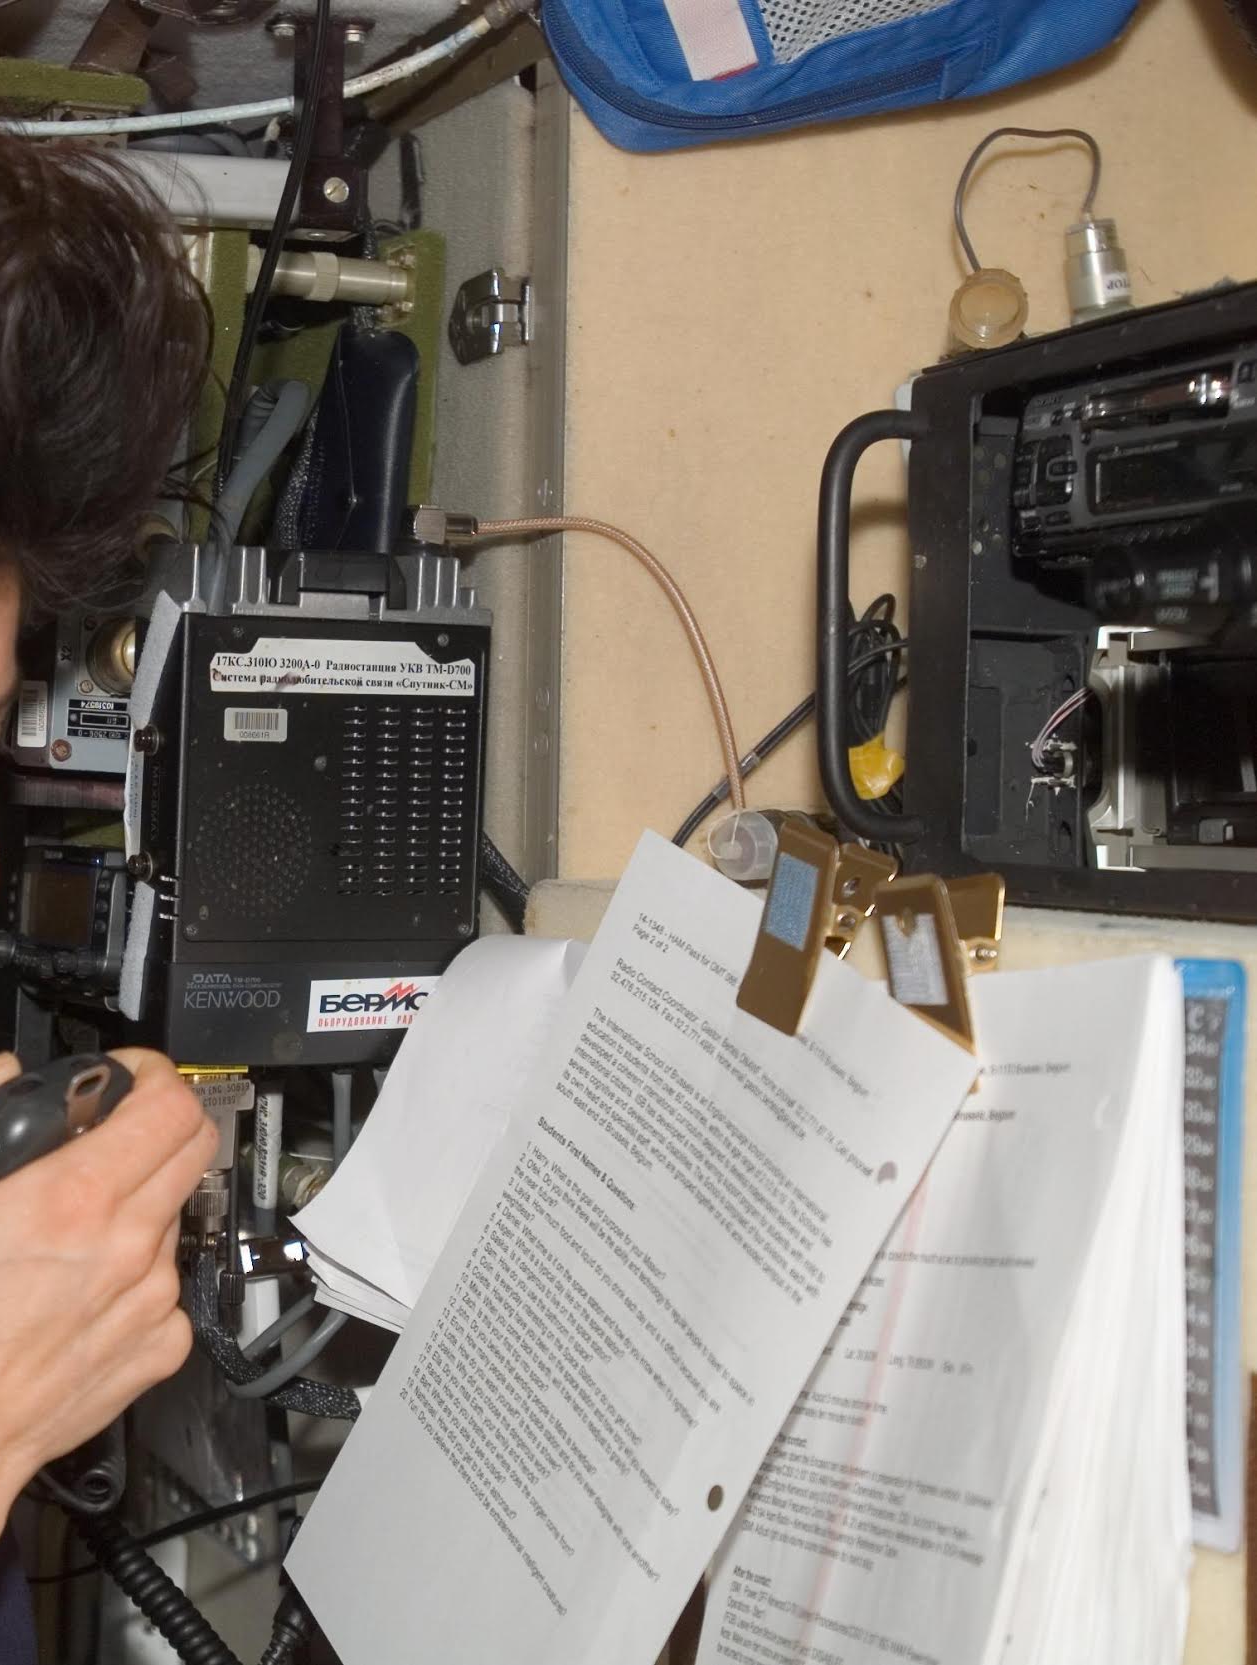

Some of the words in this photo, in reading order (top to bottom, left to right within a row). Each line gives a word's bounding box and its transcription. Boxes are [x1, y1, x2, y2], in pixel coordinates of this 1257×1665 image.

[364, 677, 394, 688] связи
[632, 923, 650, 940] Page
[668, 933, 686, 948] HAM
[616, 957, 636, 978] Radio
[636, 972, 663, 996] Contact
[183, 990, 282, 1009] KENWOOD
[586, 1021, 617, 1046] education
[623, 1050, 649, 1074] students
[649, 1070, 663, 1082] from
[593, 1006, 606, 1023] The
[606, 1018, 643, 1051] International
[643, 1046, 664, 1068] School
[555, 1082, 574, 1098] south
[573, 1096, 588, 1112] east
[586, 1107, 600, 1121] end
[537, 1115, 567, 1146] Students
[566, 1139, 582, 1160] First
[579, 1152, 601, 1178] Names
[600, 1171, 607, 1183] &
[514, 1165, 524, 1179] the
[524, 1175, 538, 1189] near
[550, 1163, 567, 1181] What
[571, 1182, 581, 1196] the
[591, 1204, 604, 1218] and
[515, 1238, 531, 1254] What
[498, 1258, 510, 1273] How
[517, 1280, 526, 1292] you
[490, 1327, 504, 1340] your
[456, 1360, 467, 1378] Why
[474, 1386, 483, 1399] you
[431, 1389, 445, 1407] What
[451, 1417, 459, 1429] you
